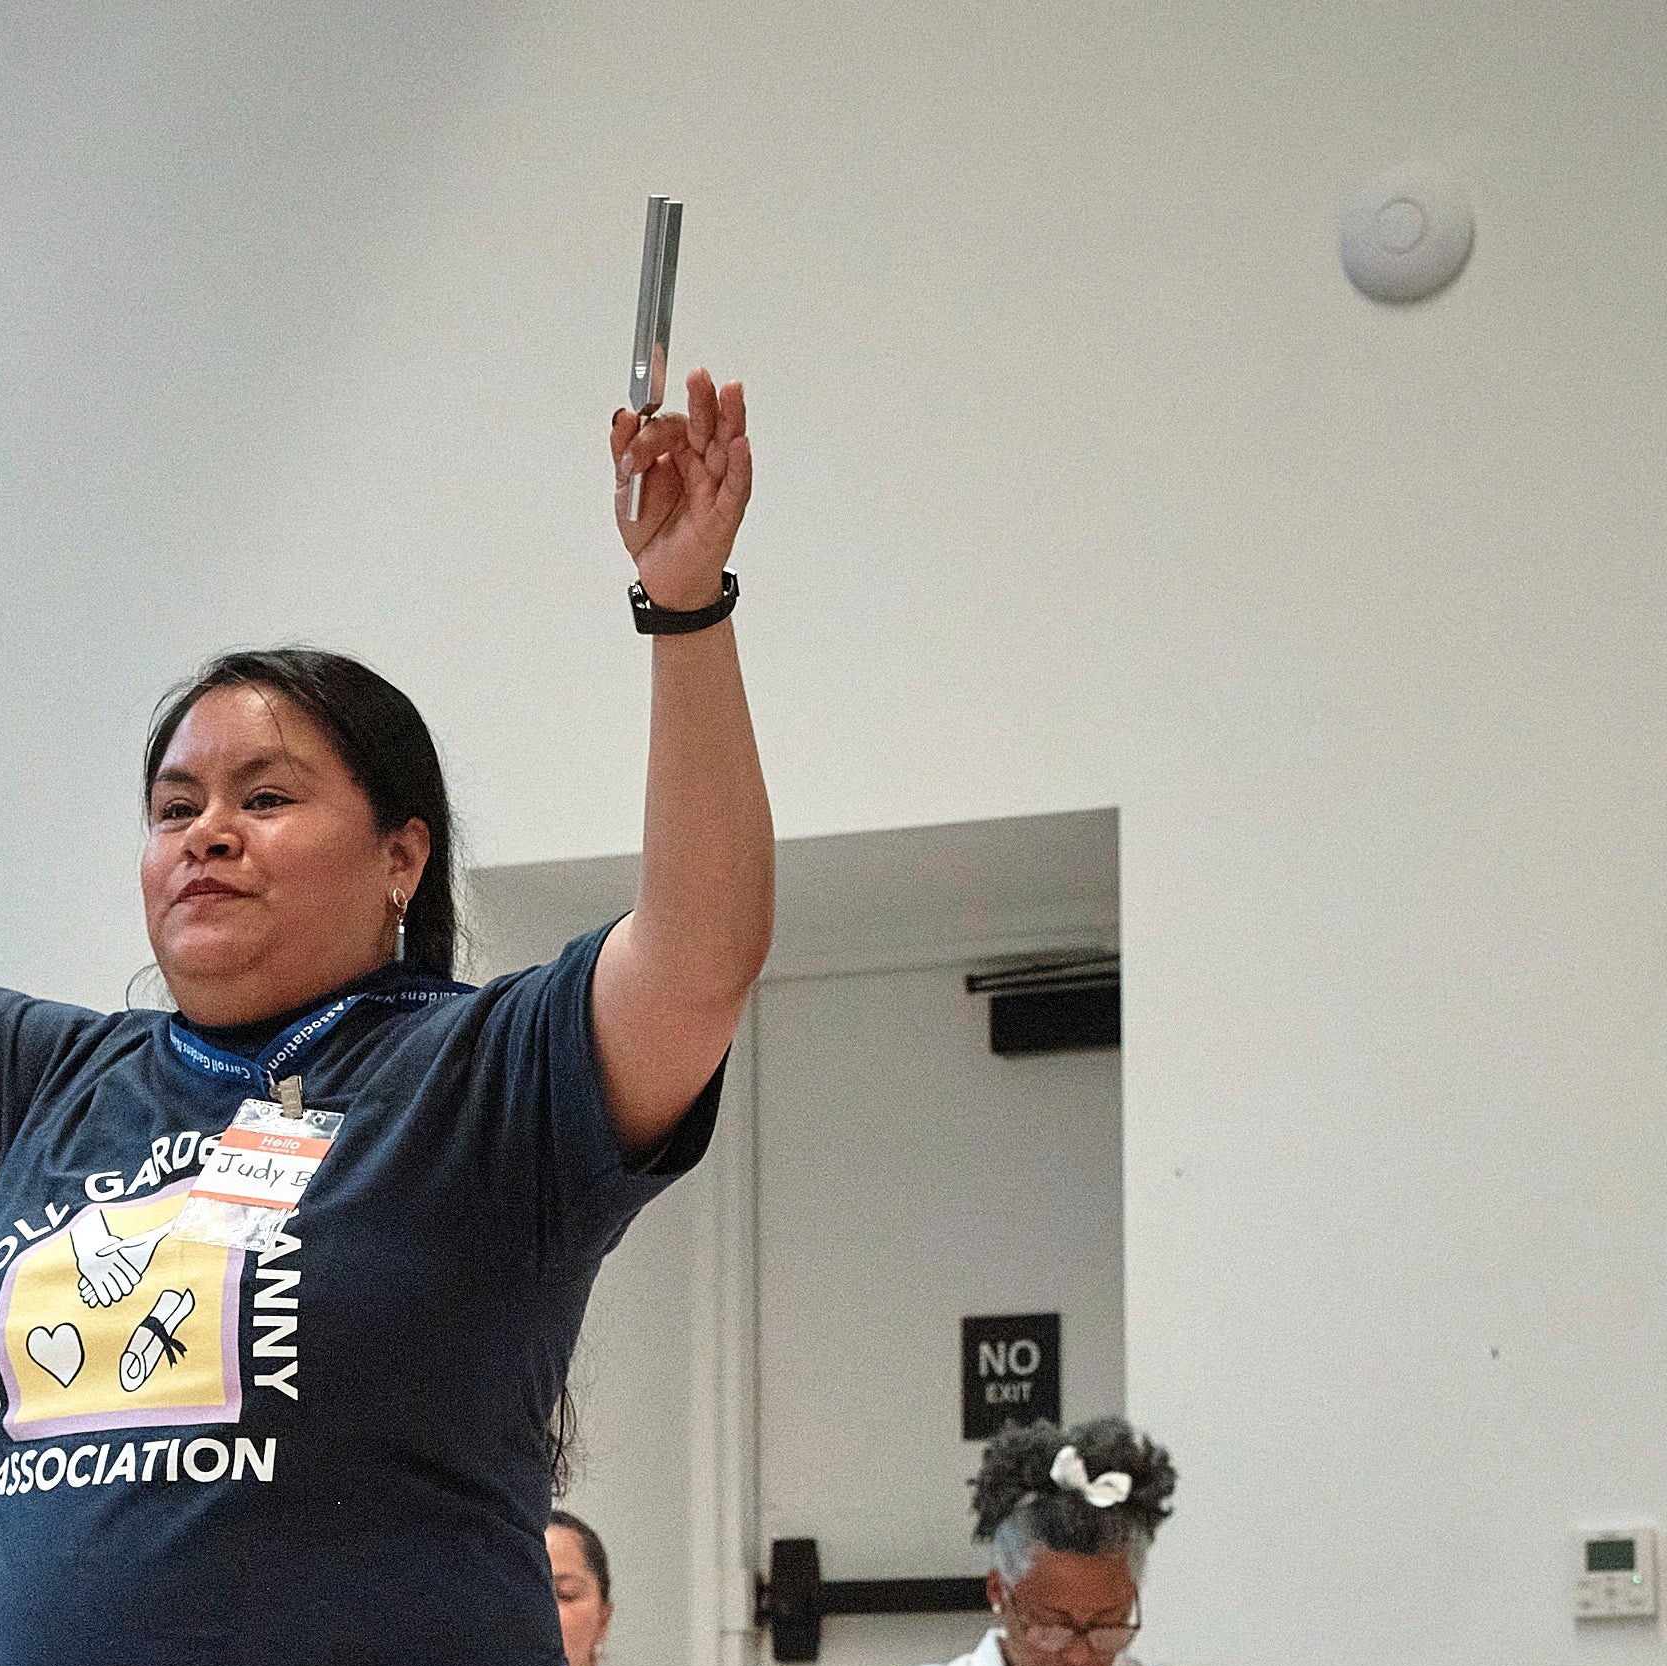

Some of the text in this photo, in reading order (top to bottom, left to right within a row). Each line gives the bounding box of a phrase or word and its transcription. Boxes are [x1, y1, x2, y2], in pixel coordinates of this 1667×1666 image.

[267, 1001, 345, 1070] Association
[211, 1059, 251, 1080] Carroll
[260, 1135, 301, 1150] Hello
[84, 1130, 225, 1202] GARDE
[217, 1152, 314, 1188] Judy B
[252, 1210, 302, 1401] ANNY
[978, 1340, 1040, 1377] NO
[986, 1381, 1032, 1403] EXIT
